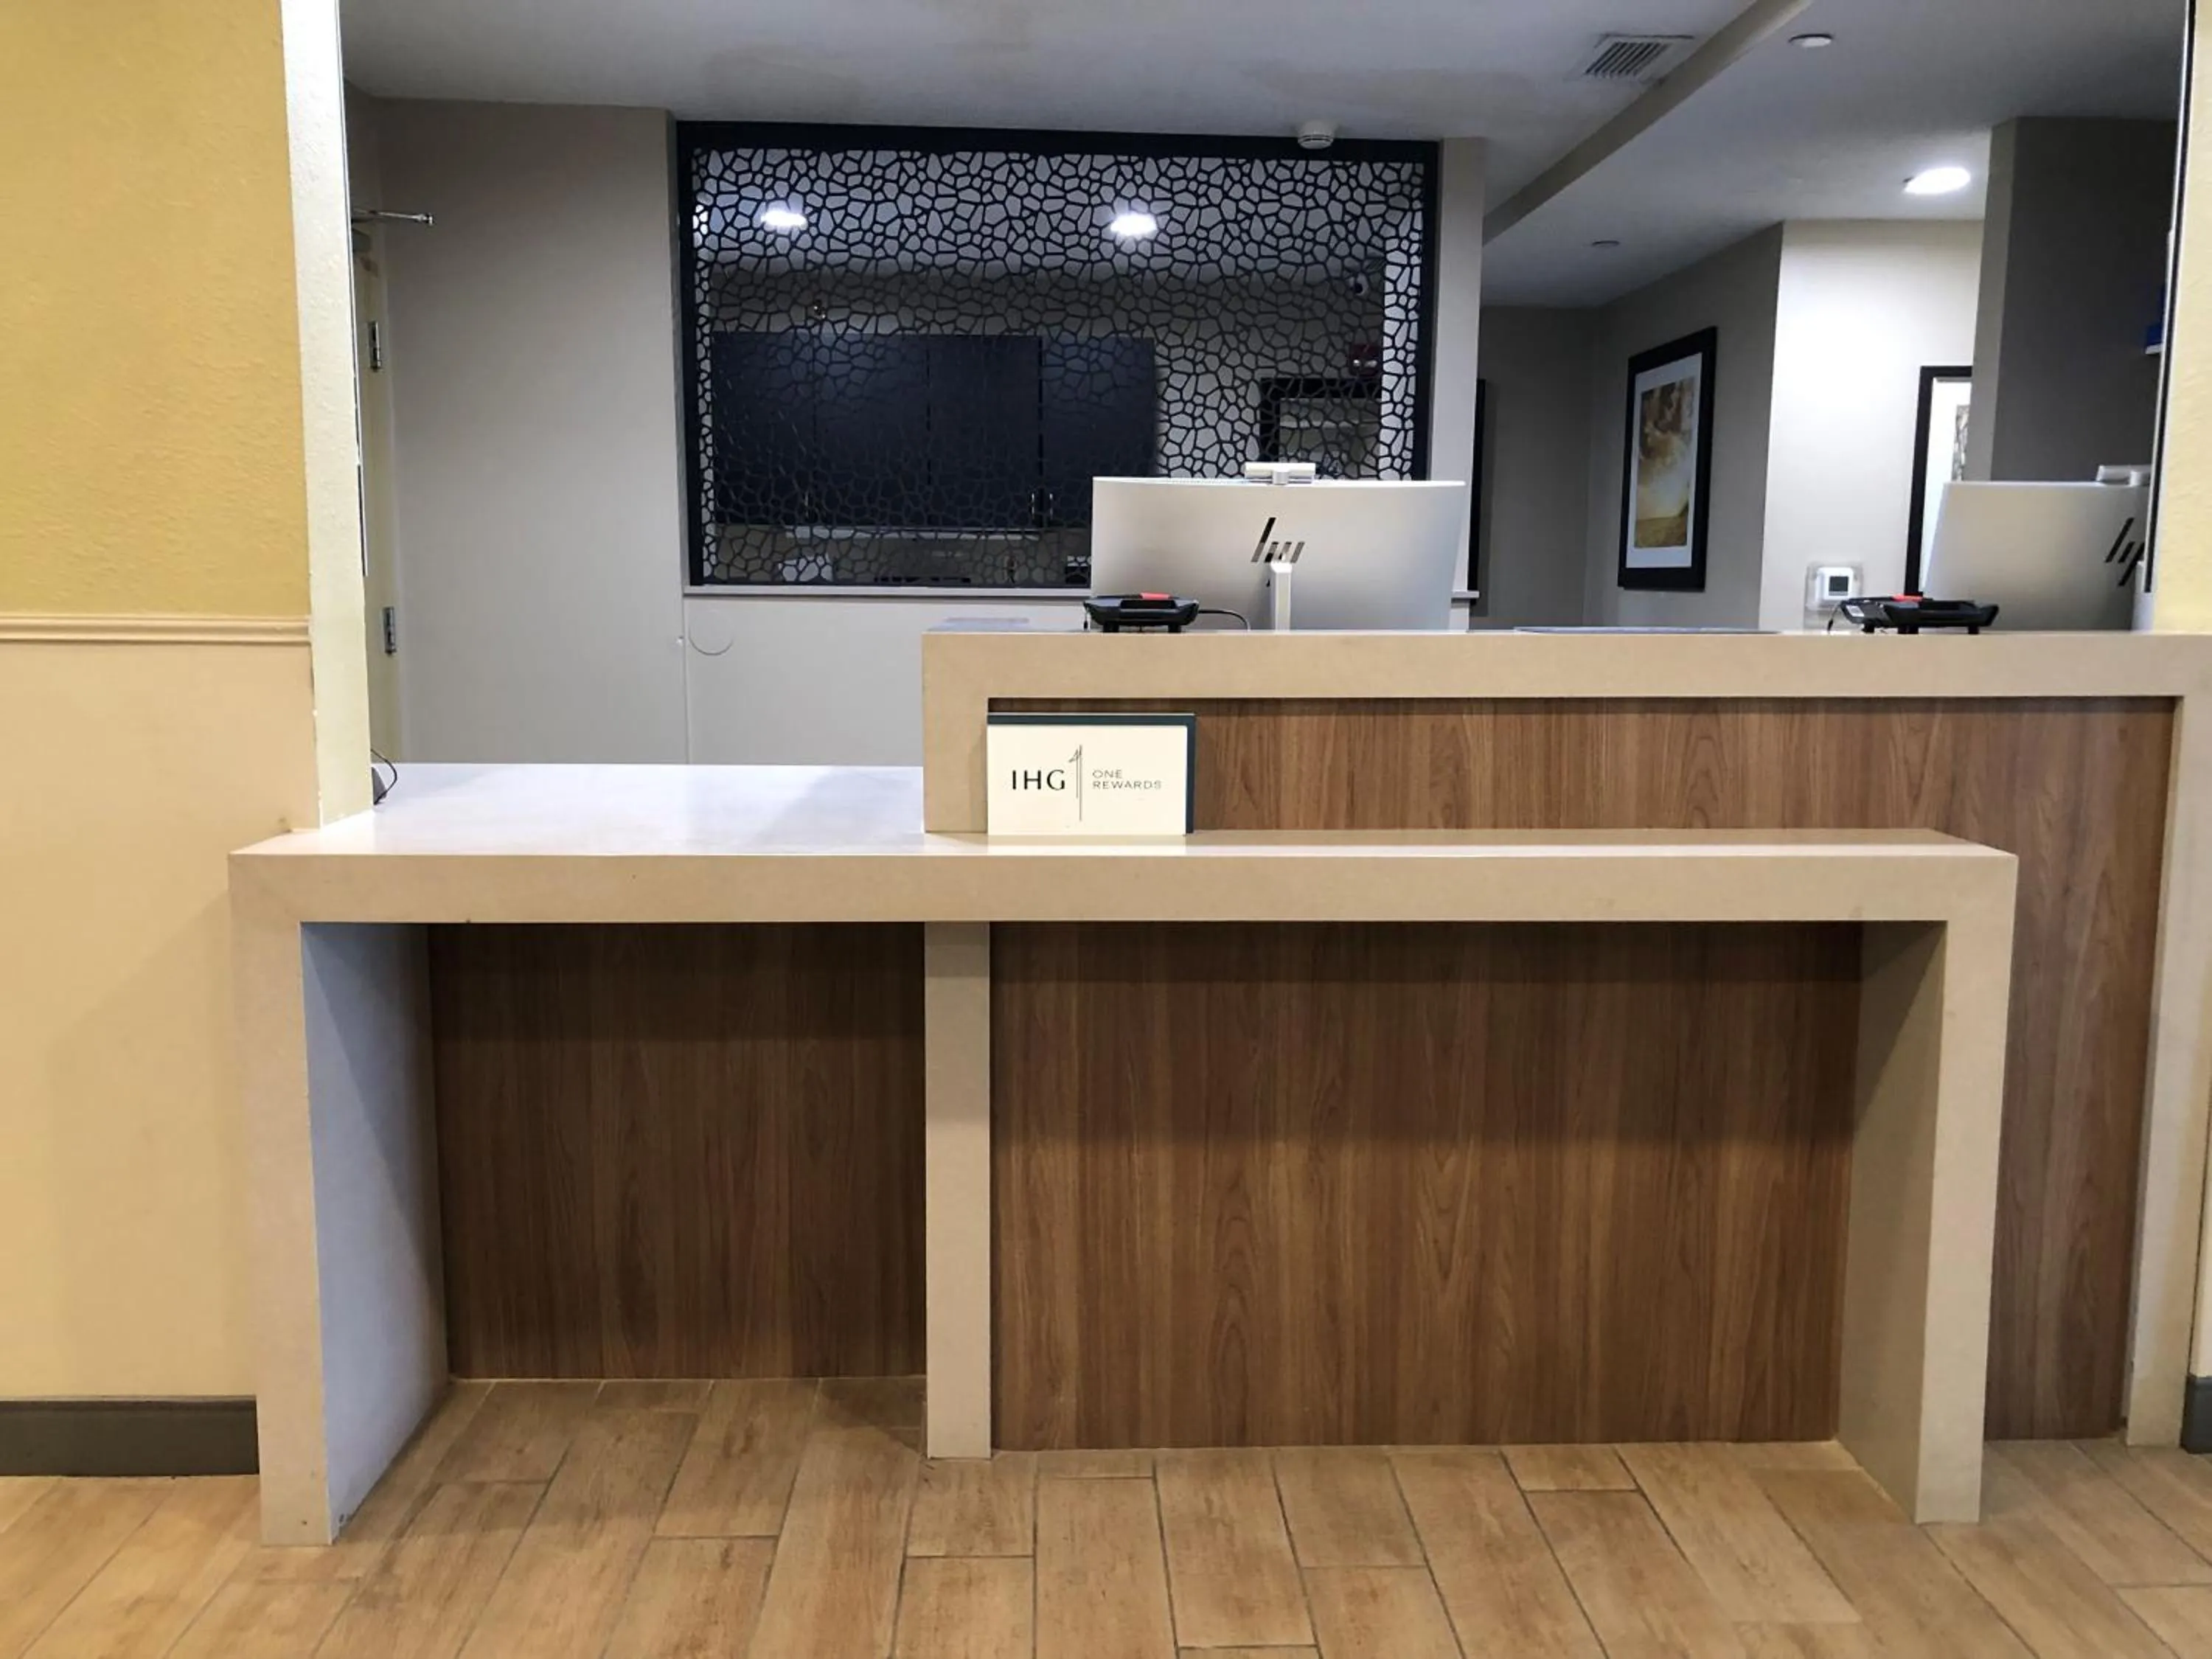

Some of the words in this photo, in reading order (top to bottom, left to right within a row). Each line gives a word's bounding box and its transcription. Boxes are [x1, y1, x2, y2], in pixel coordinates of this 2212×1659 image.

[1092, 769, 1122, 779] ONE
[1012, 769, 1065, 790] IHG
[1092, 781, 1162, 790] REWARDS
